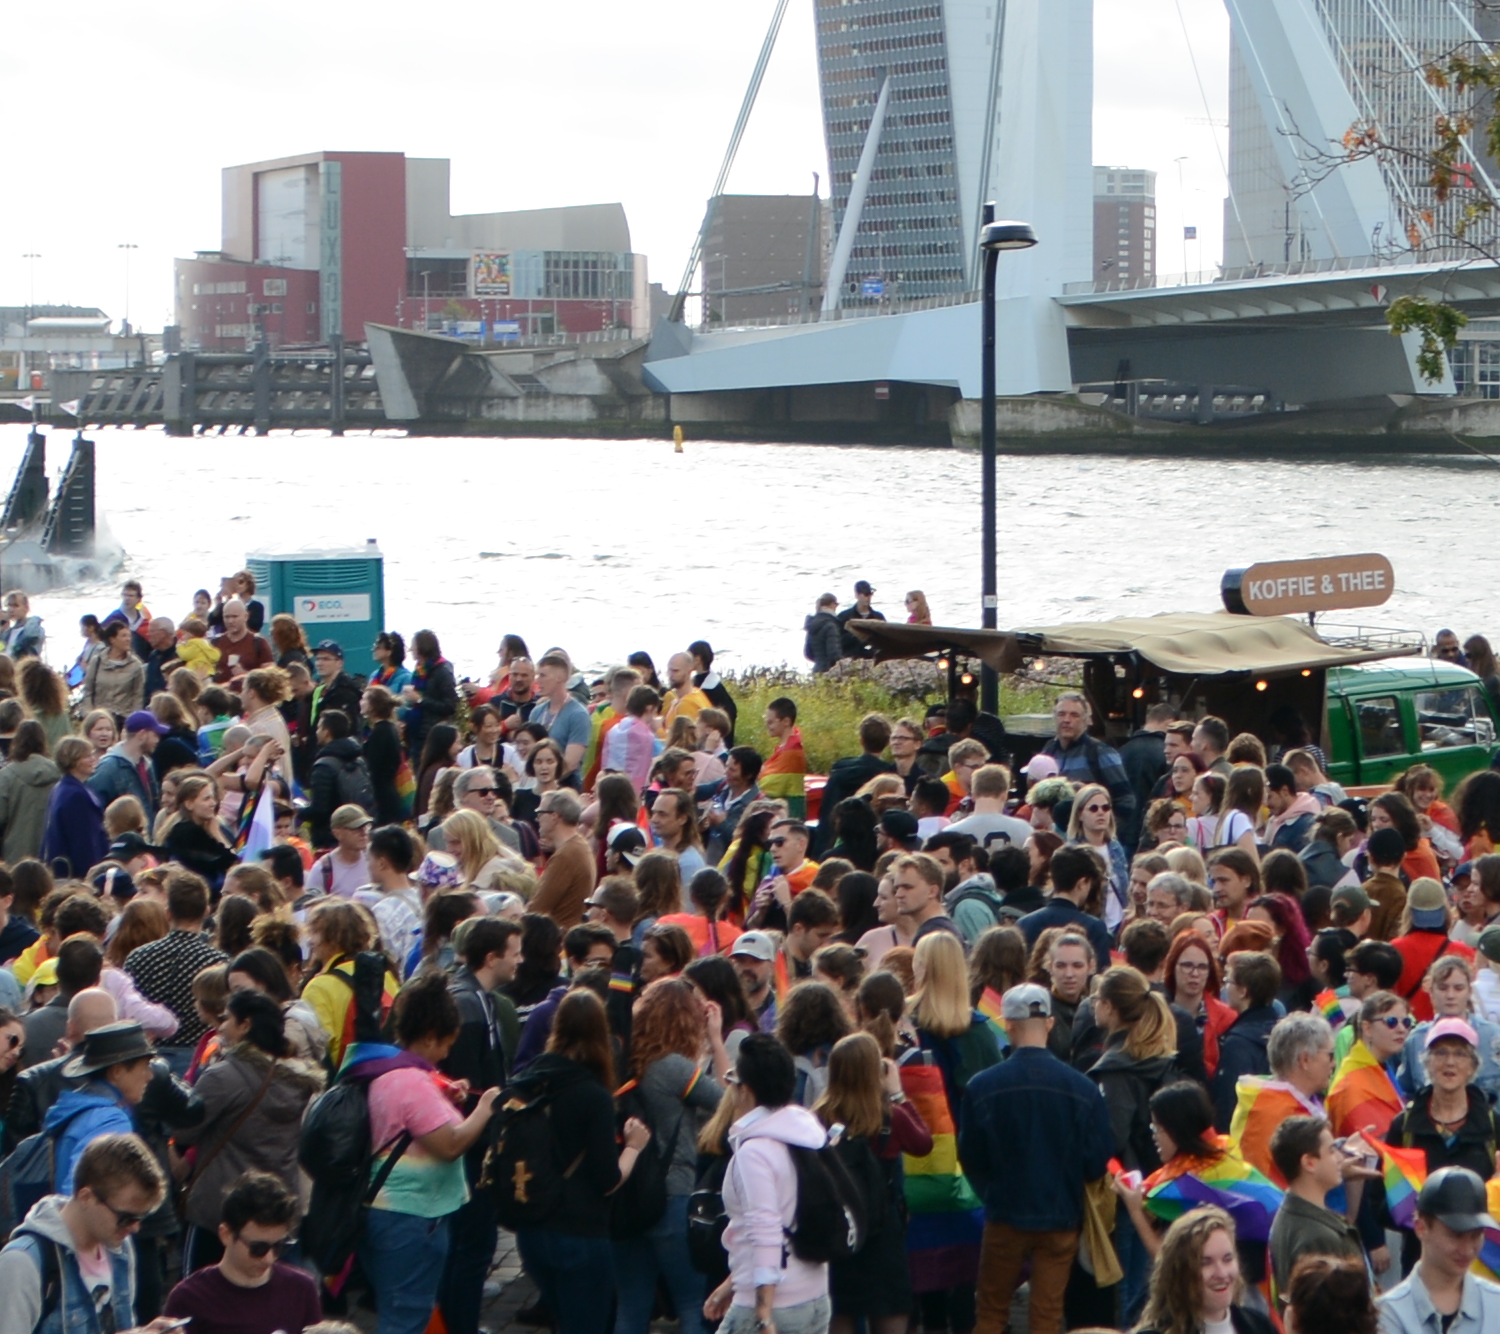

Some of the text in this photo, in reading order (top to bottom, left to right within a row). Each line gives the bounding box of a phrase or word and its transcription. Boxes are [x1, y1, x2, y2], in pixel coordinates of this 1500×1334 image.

[1249, 570, 1386, 600] KOFFIE & THEE
